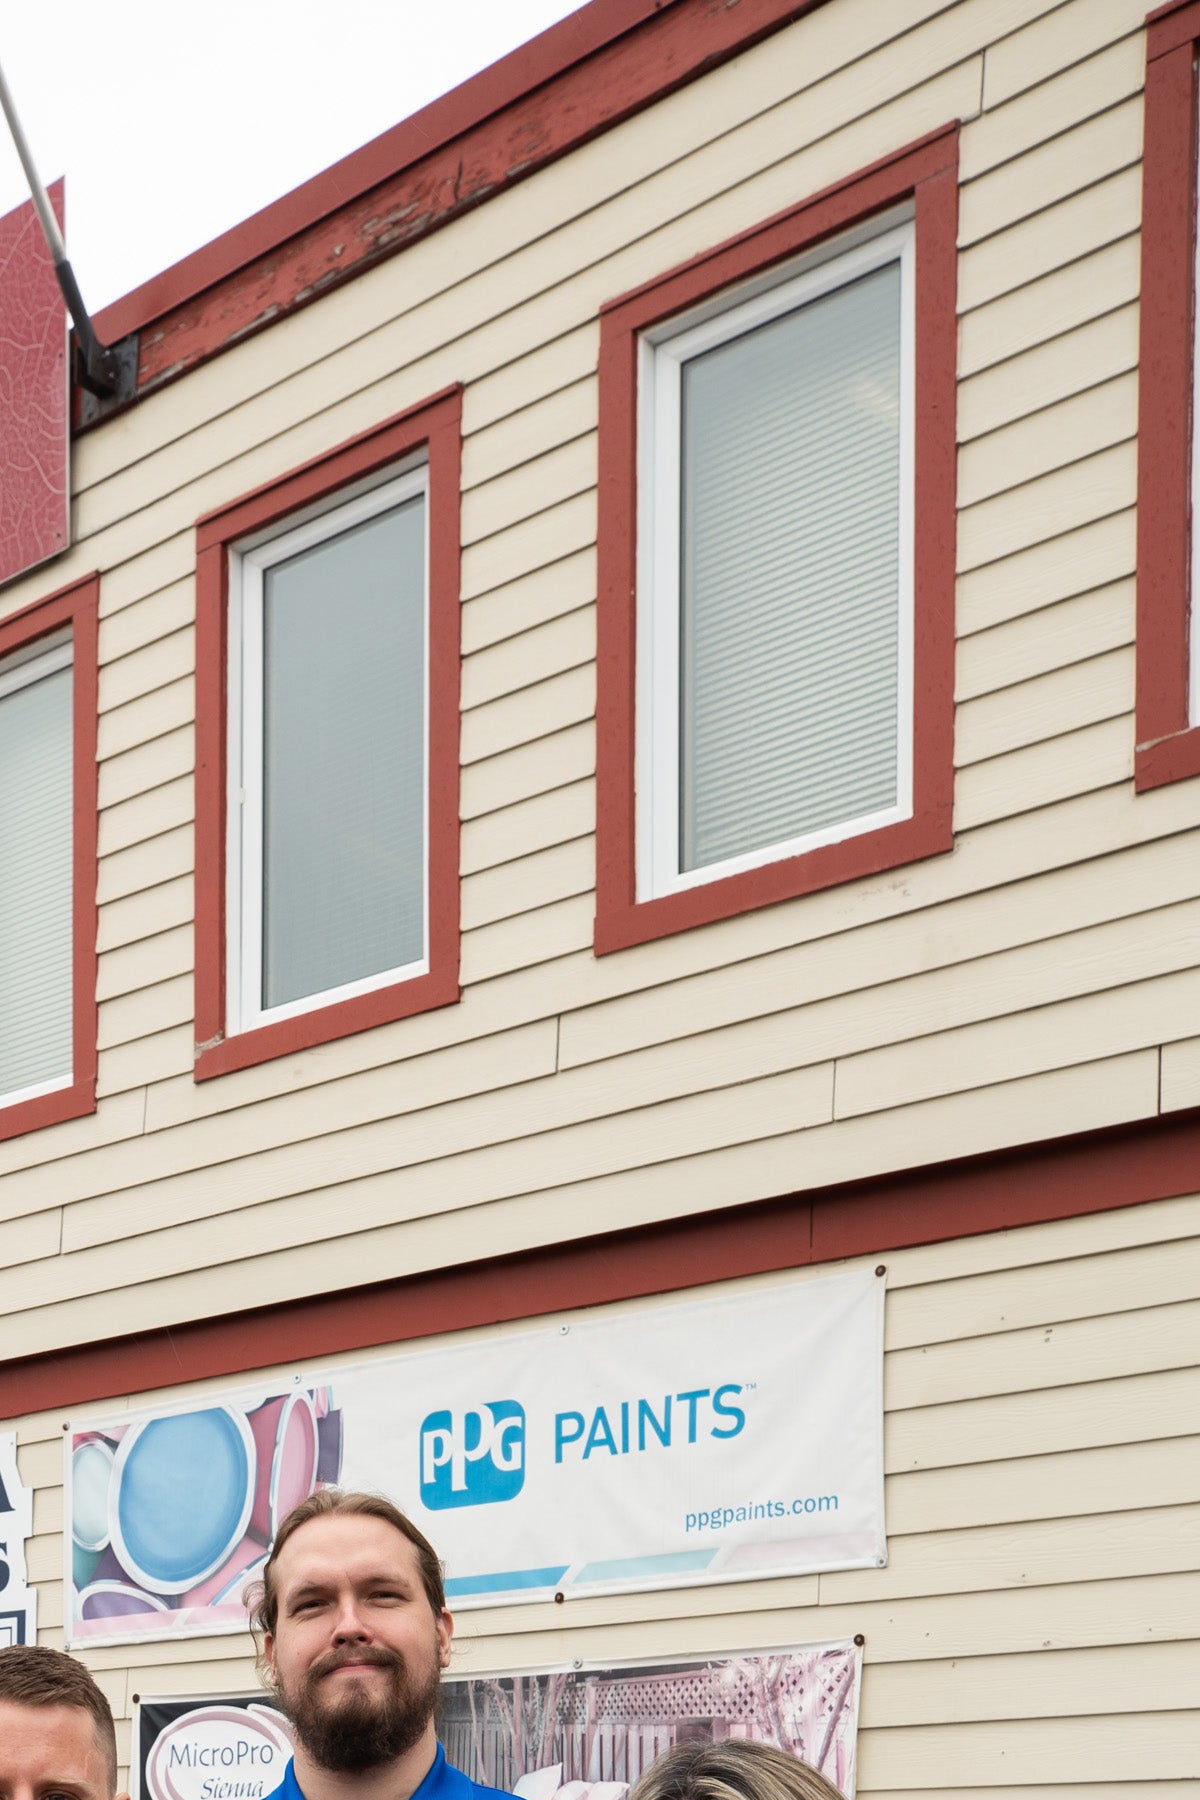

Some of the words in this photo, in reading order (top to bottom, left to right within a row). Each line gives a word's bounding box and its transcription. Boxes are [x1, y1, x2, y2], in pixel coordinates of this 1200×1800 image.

[422, 1403, 523, 1492] PPG
[554, 1383, 747, 1464] PAINTS
[684, 1493, 840, 1533] ppgpaints.com
[169, 1740, 274, 1768] MicroPro
[200, 1777, 264, 1800] Sienna
